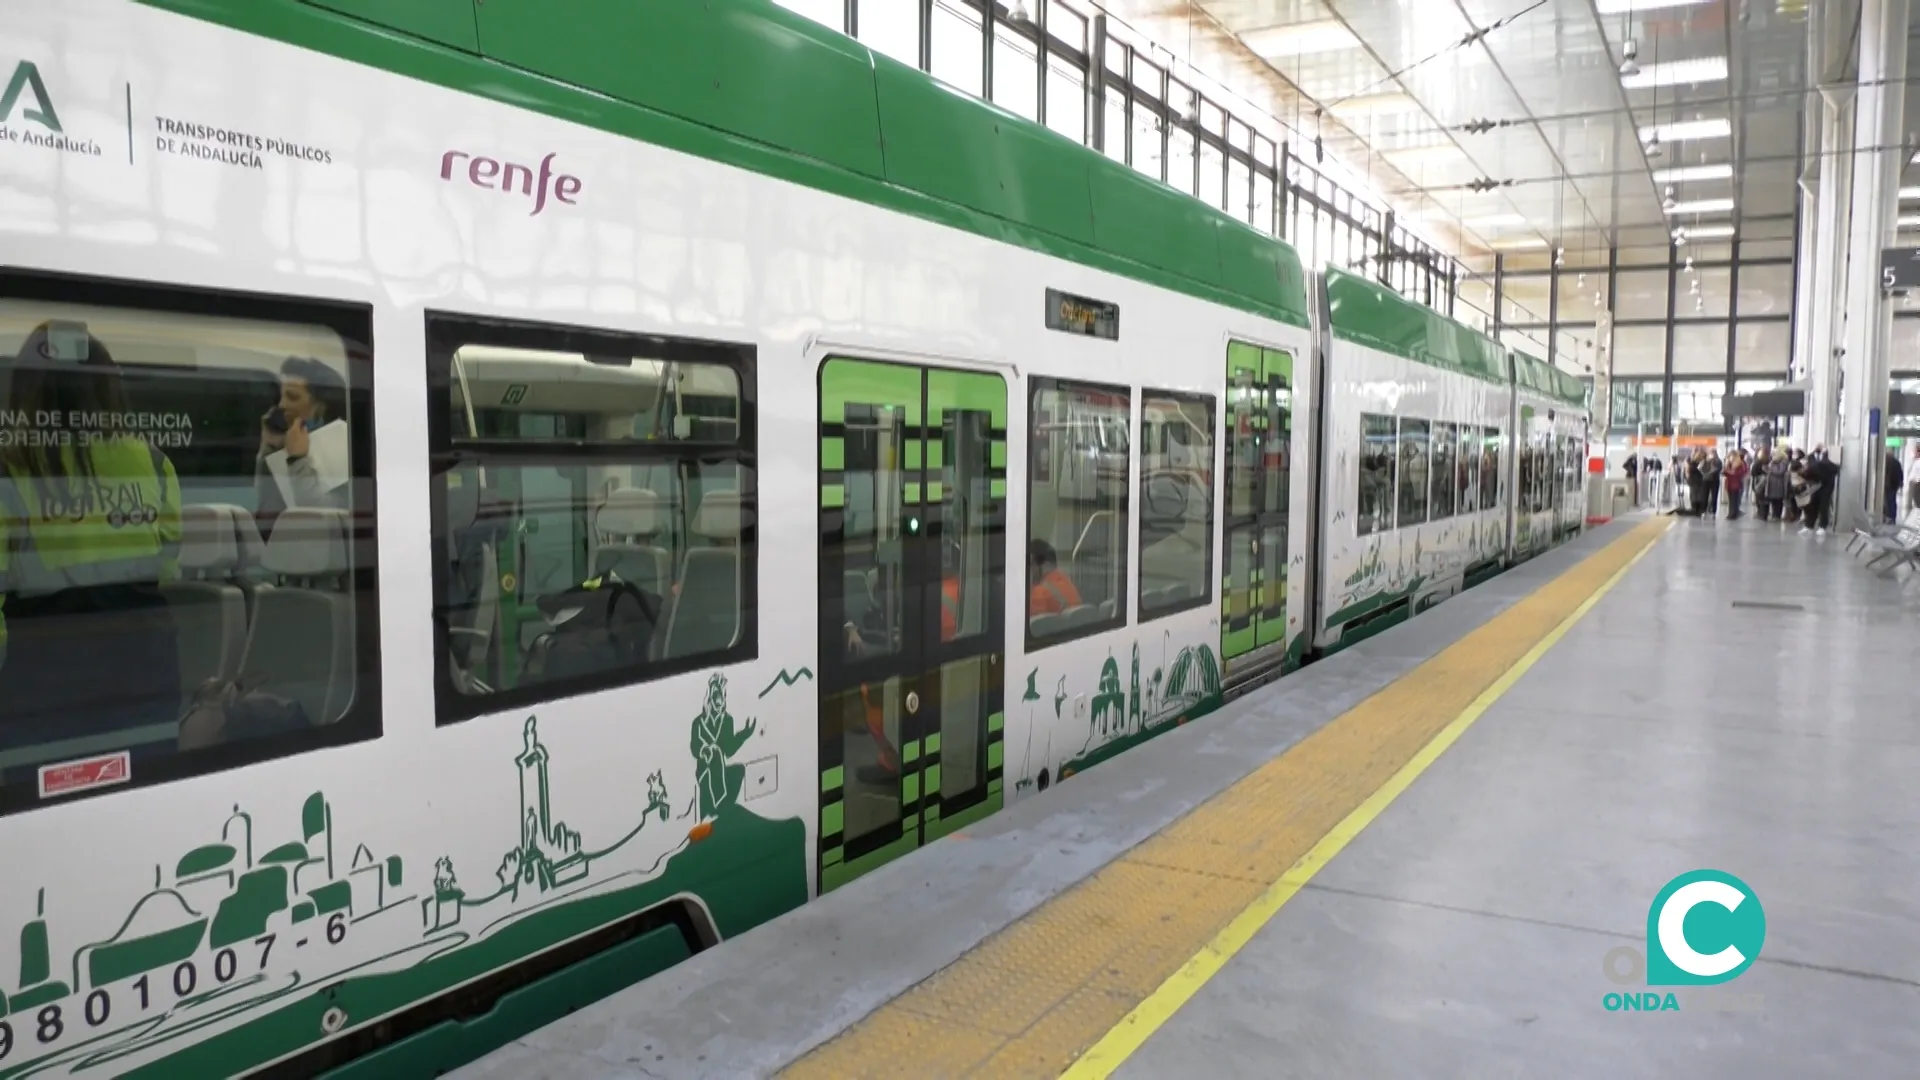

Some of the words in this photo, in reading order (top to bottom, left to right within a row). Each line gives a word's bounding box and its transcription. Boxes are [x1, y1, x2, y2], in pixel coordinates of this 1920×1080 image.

[23, 129, 102, 156] Andalucía
[155, 115, 263, 150] TRANSPORTES
[266, 138, 332, 164] PÚBLICOS
[156, 136, 176, 153] DE
[180, 142, 263, 169] ANDALUCÍA
[440, 149, 582, 217] renfe
[1883, 266, 1896, 288] 5
[36, 410, 62, 428] DE
[69, 411, 193, 430] EMERGENCIA
